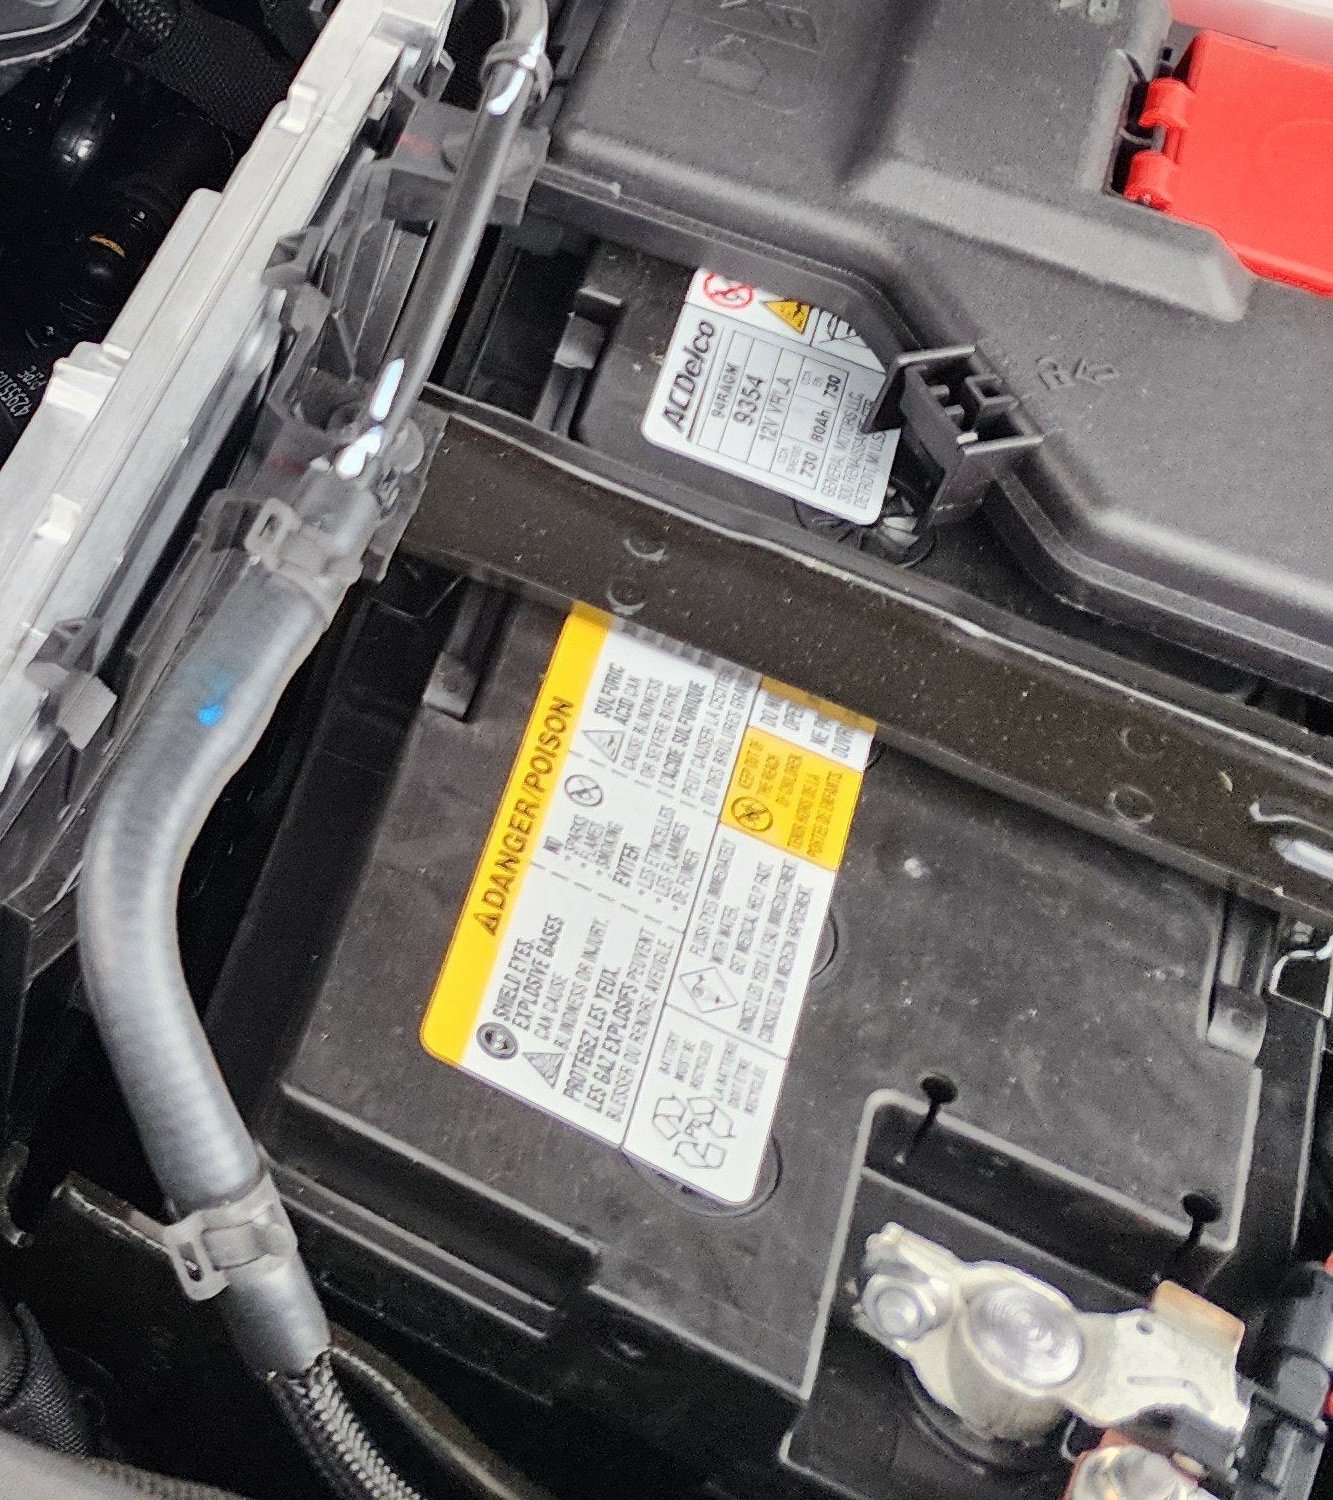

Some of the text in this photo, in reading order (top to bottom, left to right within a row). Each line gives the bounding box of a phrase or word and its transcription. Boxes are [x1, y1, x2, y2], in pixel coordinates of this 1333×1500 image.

[658, 316, 716, 434] ACDelco
[731, 372, 764, 428] 9354
[758, 414, 781, 445] 12V
[799, 372, 841, 479] 730 80Ah 730
[593, 661, 626, 719] SULFURIC
[612, 672, 643, 726] ACID CAN
[671, 679, 706, 748] SULFURIQUE
[703, 708, 721, 726] LA
[620, 676, 663, 772] CAUSE BLINDNESS
[645, 719, 670, 763] SEVERE
[689, 724, 716, 770] CAUSER
[639, 760, 658, 780] OR
[680, 767, 703, 799] PEUT
[701, 787, 719, 807] OU
[706, 765, 725, 789] DES
[480, 692, 577, 913] DANGER/POISON
[594, 819, 623, 870] SMOKING
[636, 866, 657, 890] LES
[653, 873, 673, 898] LES
[671, 886, 689, 906] DE
[491, 932, 535, 1022] SHIELD EYES.
[512, 912, 565, 1032] EXPLOSIVE GASES
[532, 970, 568, 1042] CAN CAUSE
[553, 980, 588, 1052] BLINDNESS
[574, 960, 594, 983] OR
[583, 925, 656, 1114] LES GAZ EXPLOSIFS PEUVENT
[584, 1002, 607, 1032] LES
[628, 991, 658, 1046] RENDRE
[623, 1043, 642, 1065] OU
[605, 1063, 636, 1124] BLESSER
